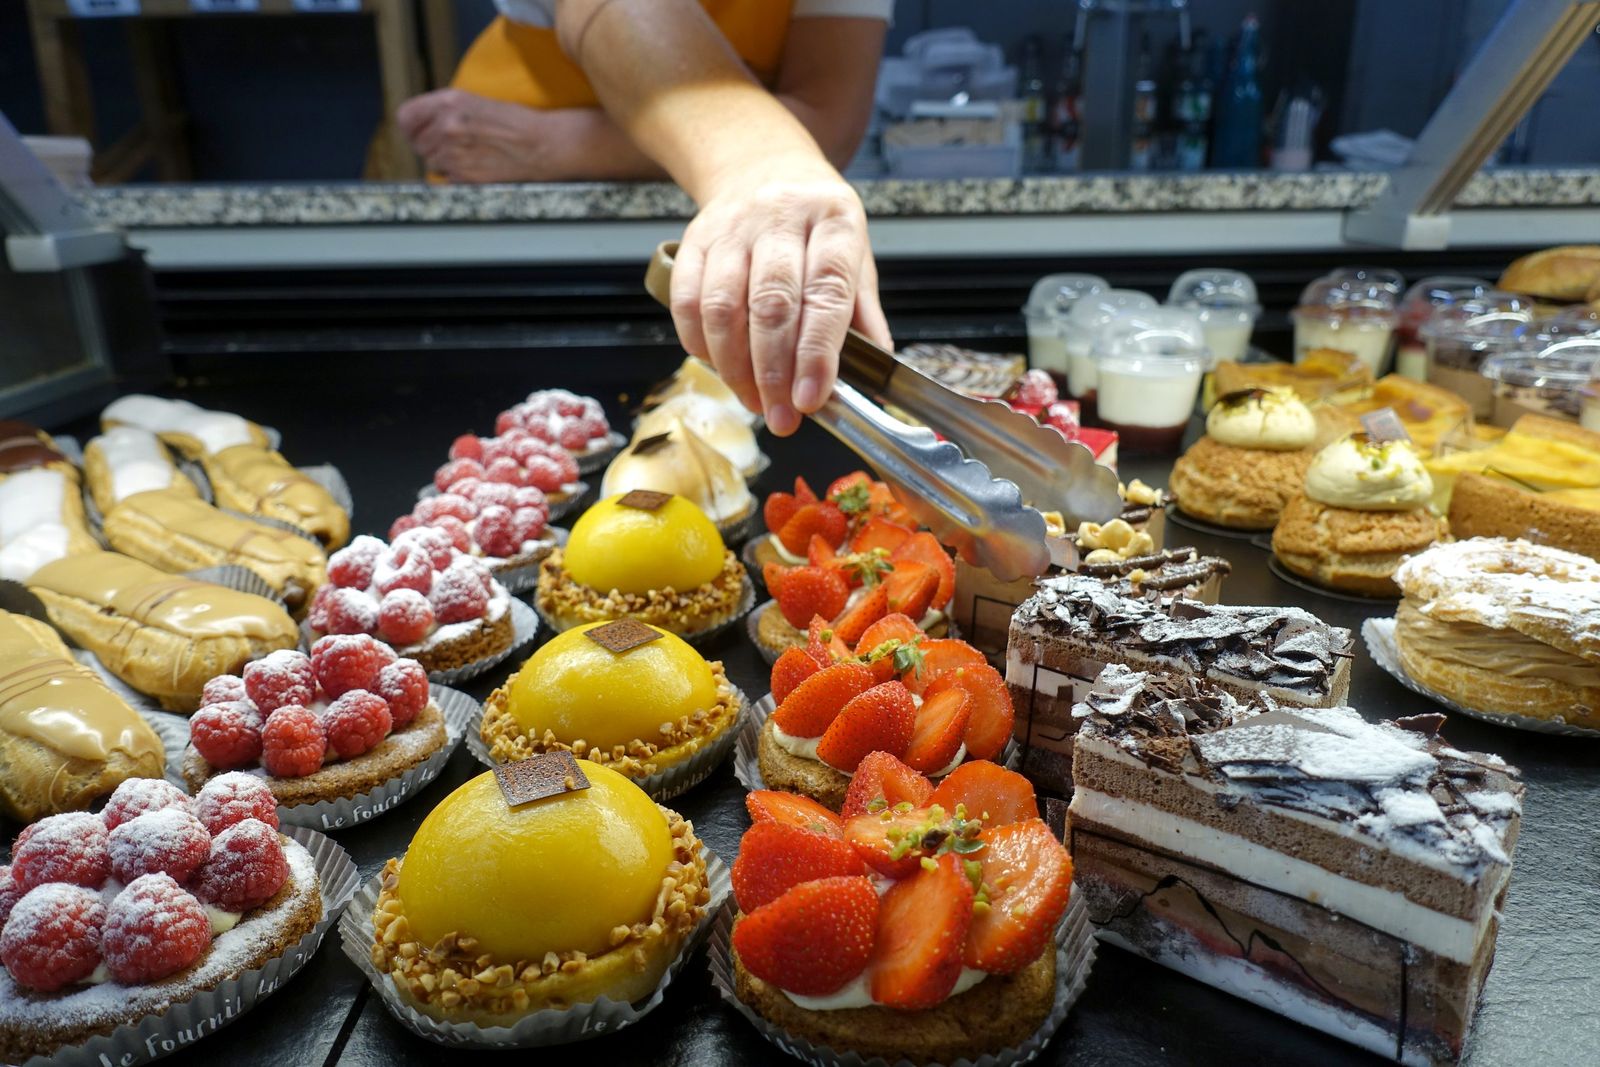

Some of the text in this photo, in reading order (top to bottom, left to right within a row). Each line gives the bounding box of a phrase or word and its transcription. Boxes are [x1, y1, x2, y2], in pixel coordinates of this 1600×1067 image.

[320, 813, 345, 830] Le
[98, 1052, 133, 1067] Le
[145, 995, 243, 1058] Fournil
[580, 1016, 608, 1034] Le
